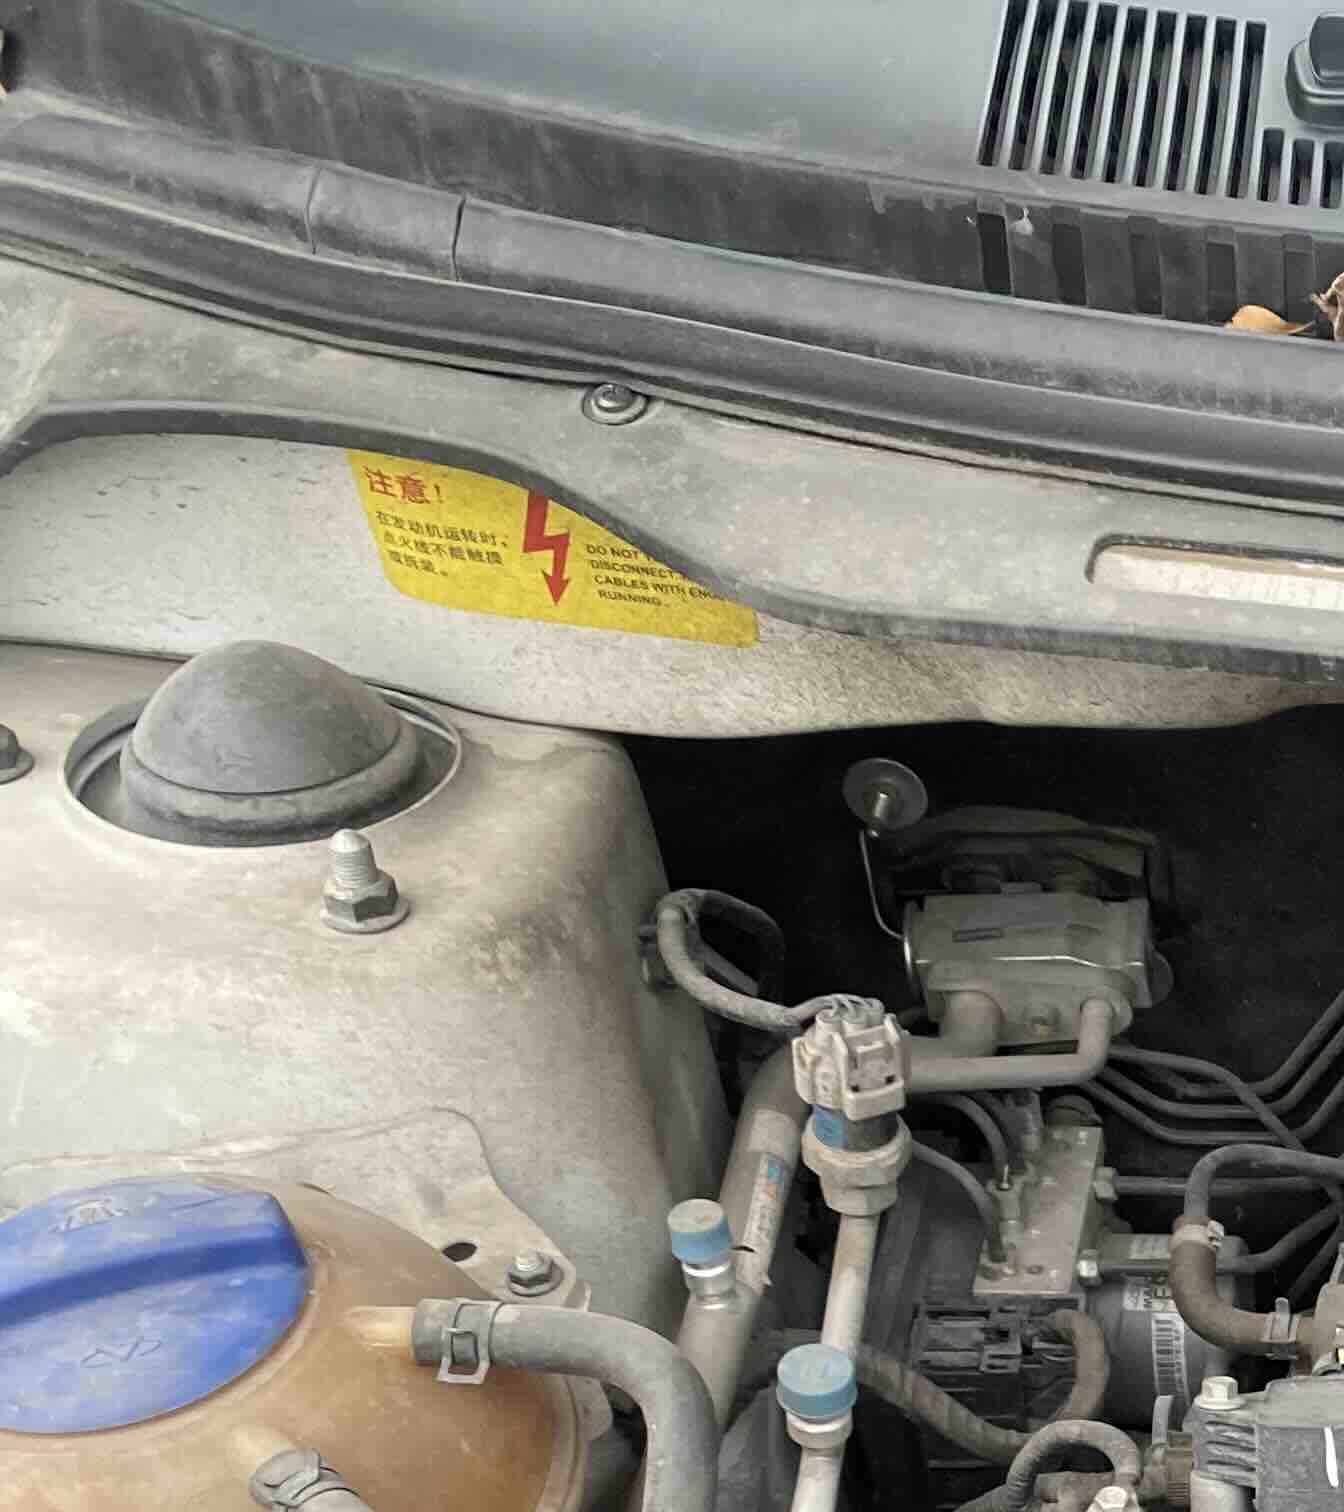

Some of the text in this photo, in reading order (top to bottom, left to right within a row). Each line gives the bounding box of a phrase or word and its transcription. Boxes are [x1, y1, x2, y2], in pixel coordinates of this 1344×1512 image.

[586, 544, 608, 556] DO
[610, 546, 640, 561] NOT
[590, 559, 674, 579] DISCONNECT
[594, 574, 649, 591] CABLES
[653, 583, 688, 597] WITH
